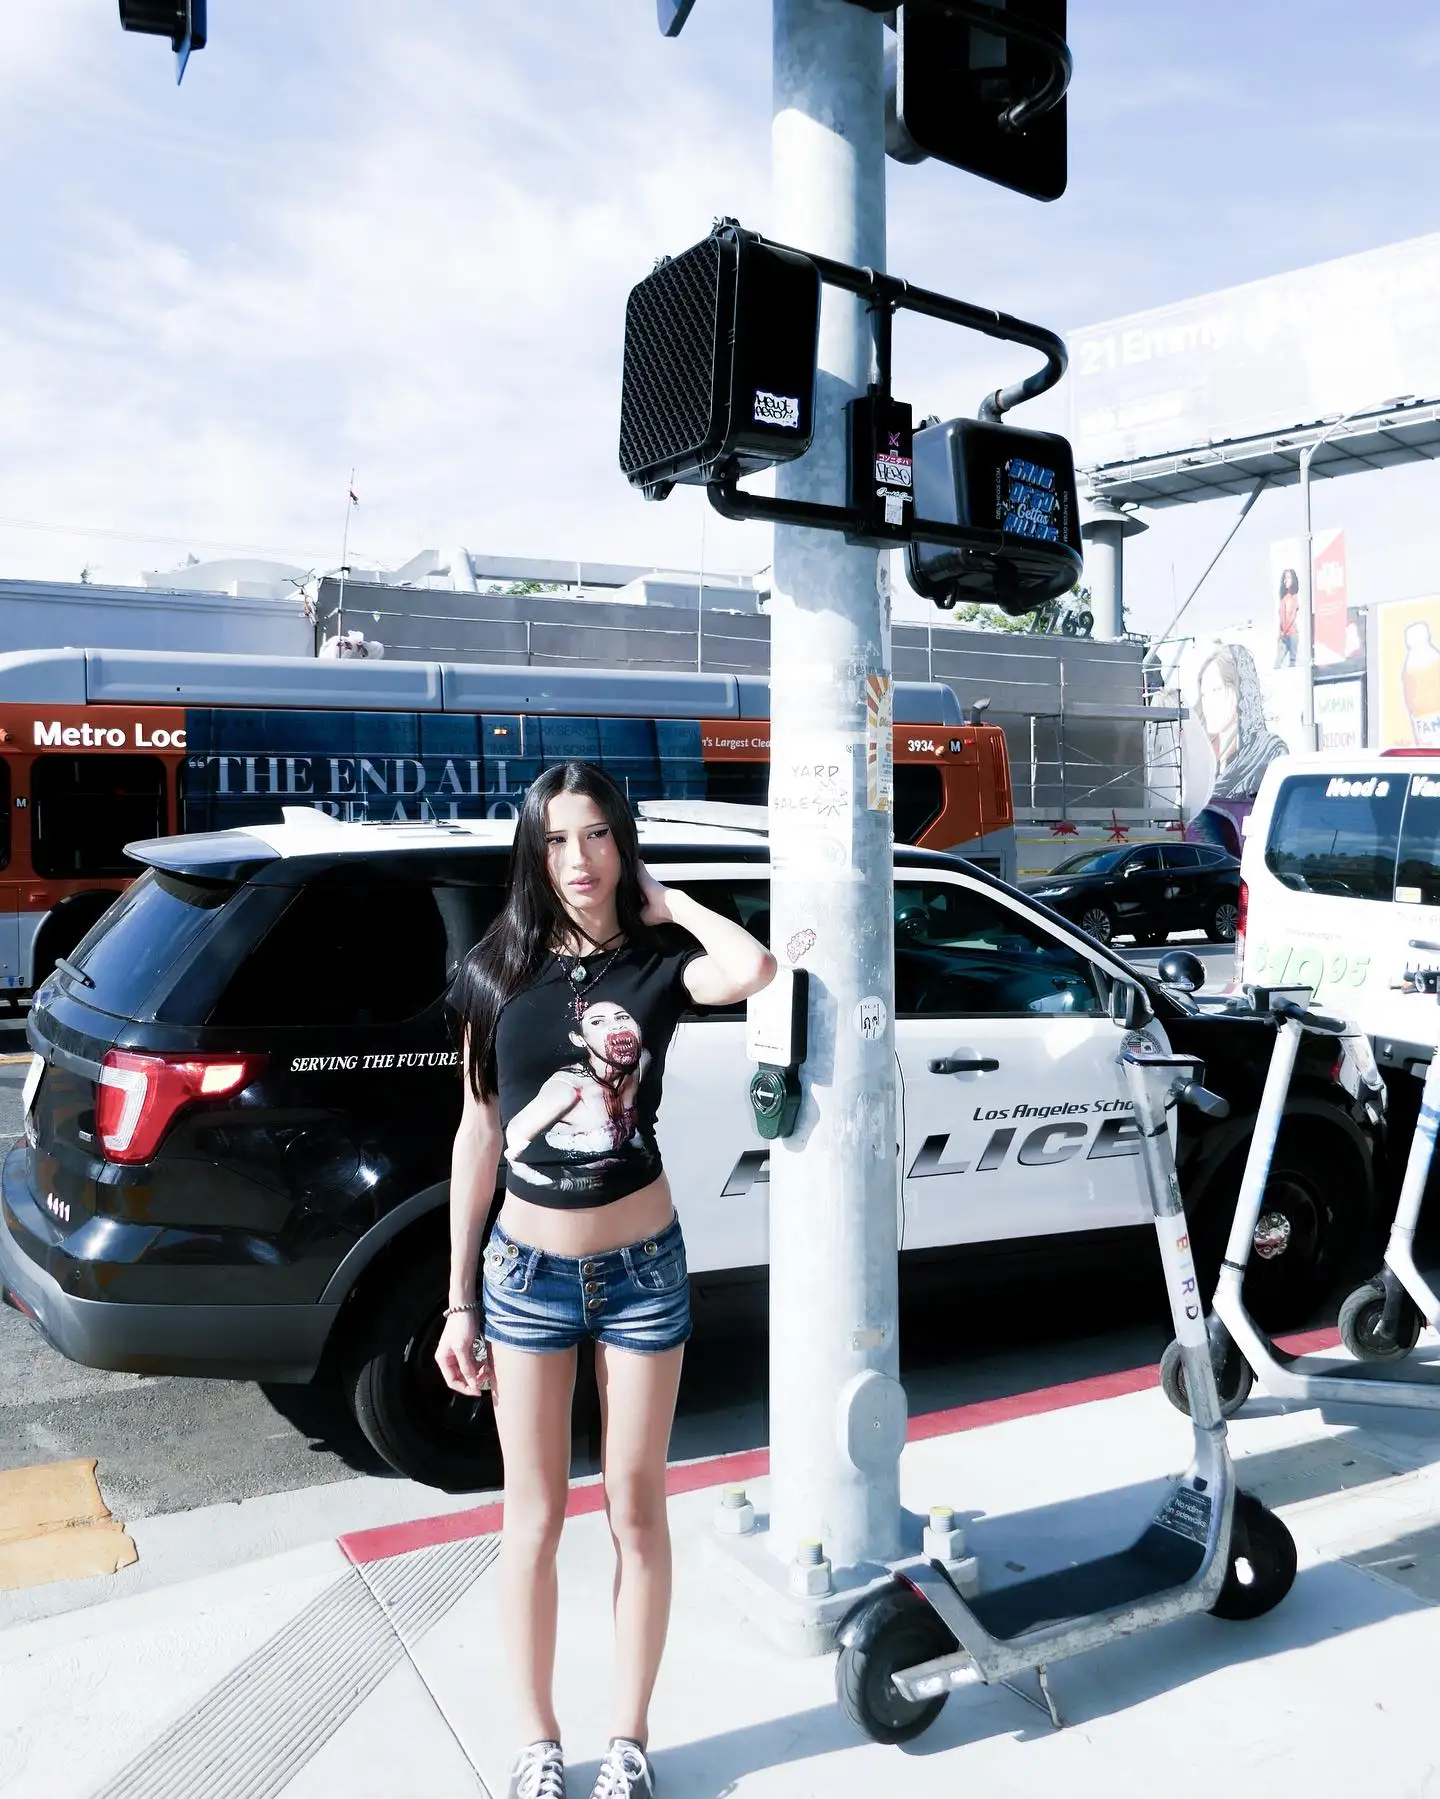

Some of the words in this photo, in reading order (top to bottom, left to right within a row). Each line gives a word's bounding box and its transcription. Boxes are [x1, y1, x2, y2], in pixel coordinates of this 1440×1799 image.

[33, 720, 126, 747] Metro
[135, 722, 187, 748] Loc
[715, 736, 749, 750] Largest
[907, 739, 935, 752] 3934
[950, 740, 962, 753] M
[326, 757, 424, 795] END
[791, 764, 840, 779] YARD
[1325, 776, 1378, 798] Need
[1374, 780, 1391, 798] a
[773, 796, 811, 810] SALE
[290, 1055, 358, 1072] SERVING
[362, 1053, 395, 1069] THE
[972, 1106, 1009, 1122] Los
[1012, 1102, 1090, 1120] Angeles
[1176, 1233, 1199, 1320] BIRD
[1175, 1509, 1208, 1528] sidewalks
